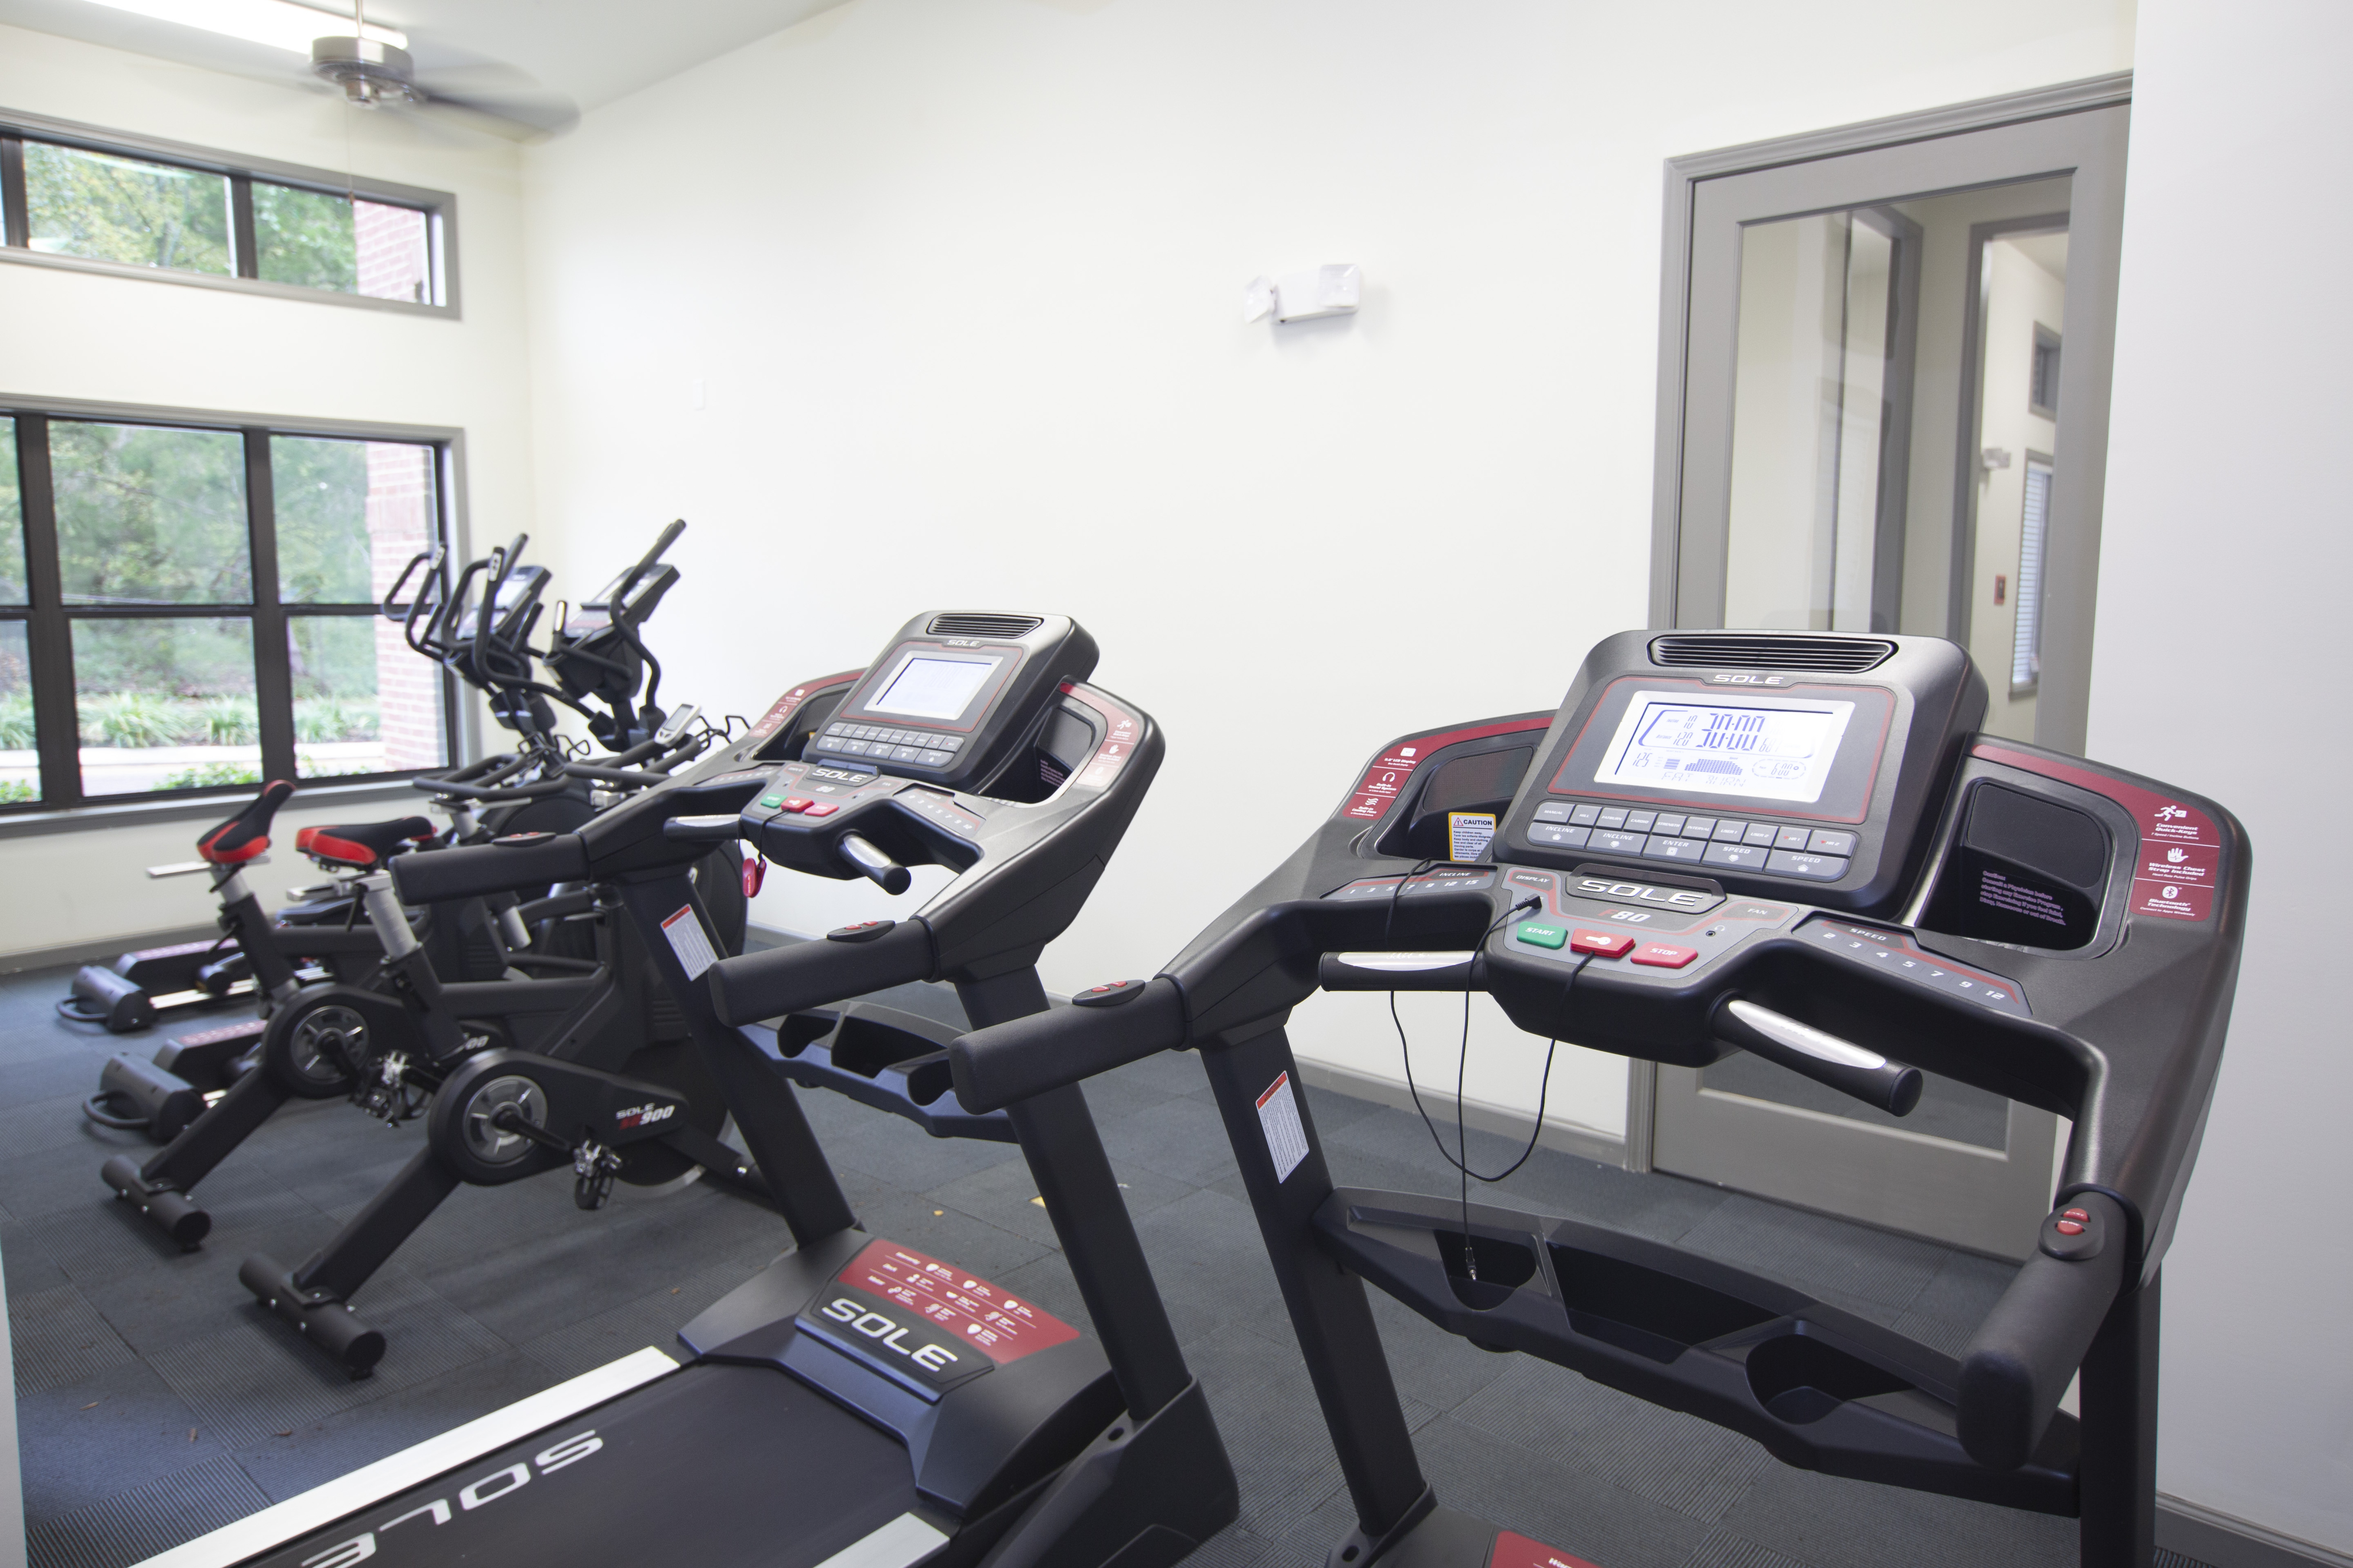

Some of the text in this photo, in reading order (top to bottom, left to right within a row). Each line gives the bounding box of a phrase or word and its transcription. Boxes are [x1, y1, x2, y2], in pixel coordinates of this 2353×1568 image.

[1713, 674, 1783, 685] SOLE
[812, 768, 867, 782] SOLE
[2155, 827, 2197, 835] Quick-Keys
[1603, 833, 1634, 841] INCLINE
[1516, 875, 1550, 883] DISPLAY
[1577, 879, 1703, 906] SOLE
[2147, 902, 2191, 912] Technology
[1598, 909, 1650, 922] F80
[1525, 927, 1556, 936] START
[1849, 928, 1887, 941] SPEED
[1650, 948, 1678, 957] STOP
[1985, 990, 2005, 1000] 12
[616, 1103, 655, 1119] SOLE
[821, 1298, 958, 1372] SOLE
